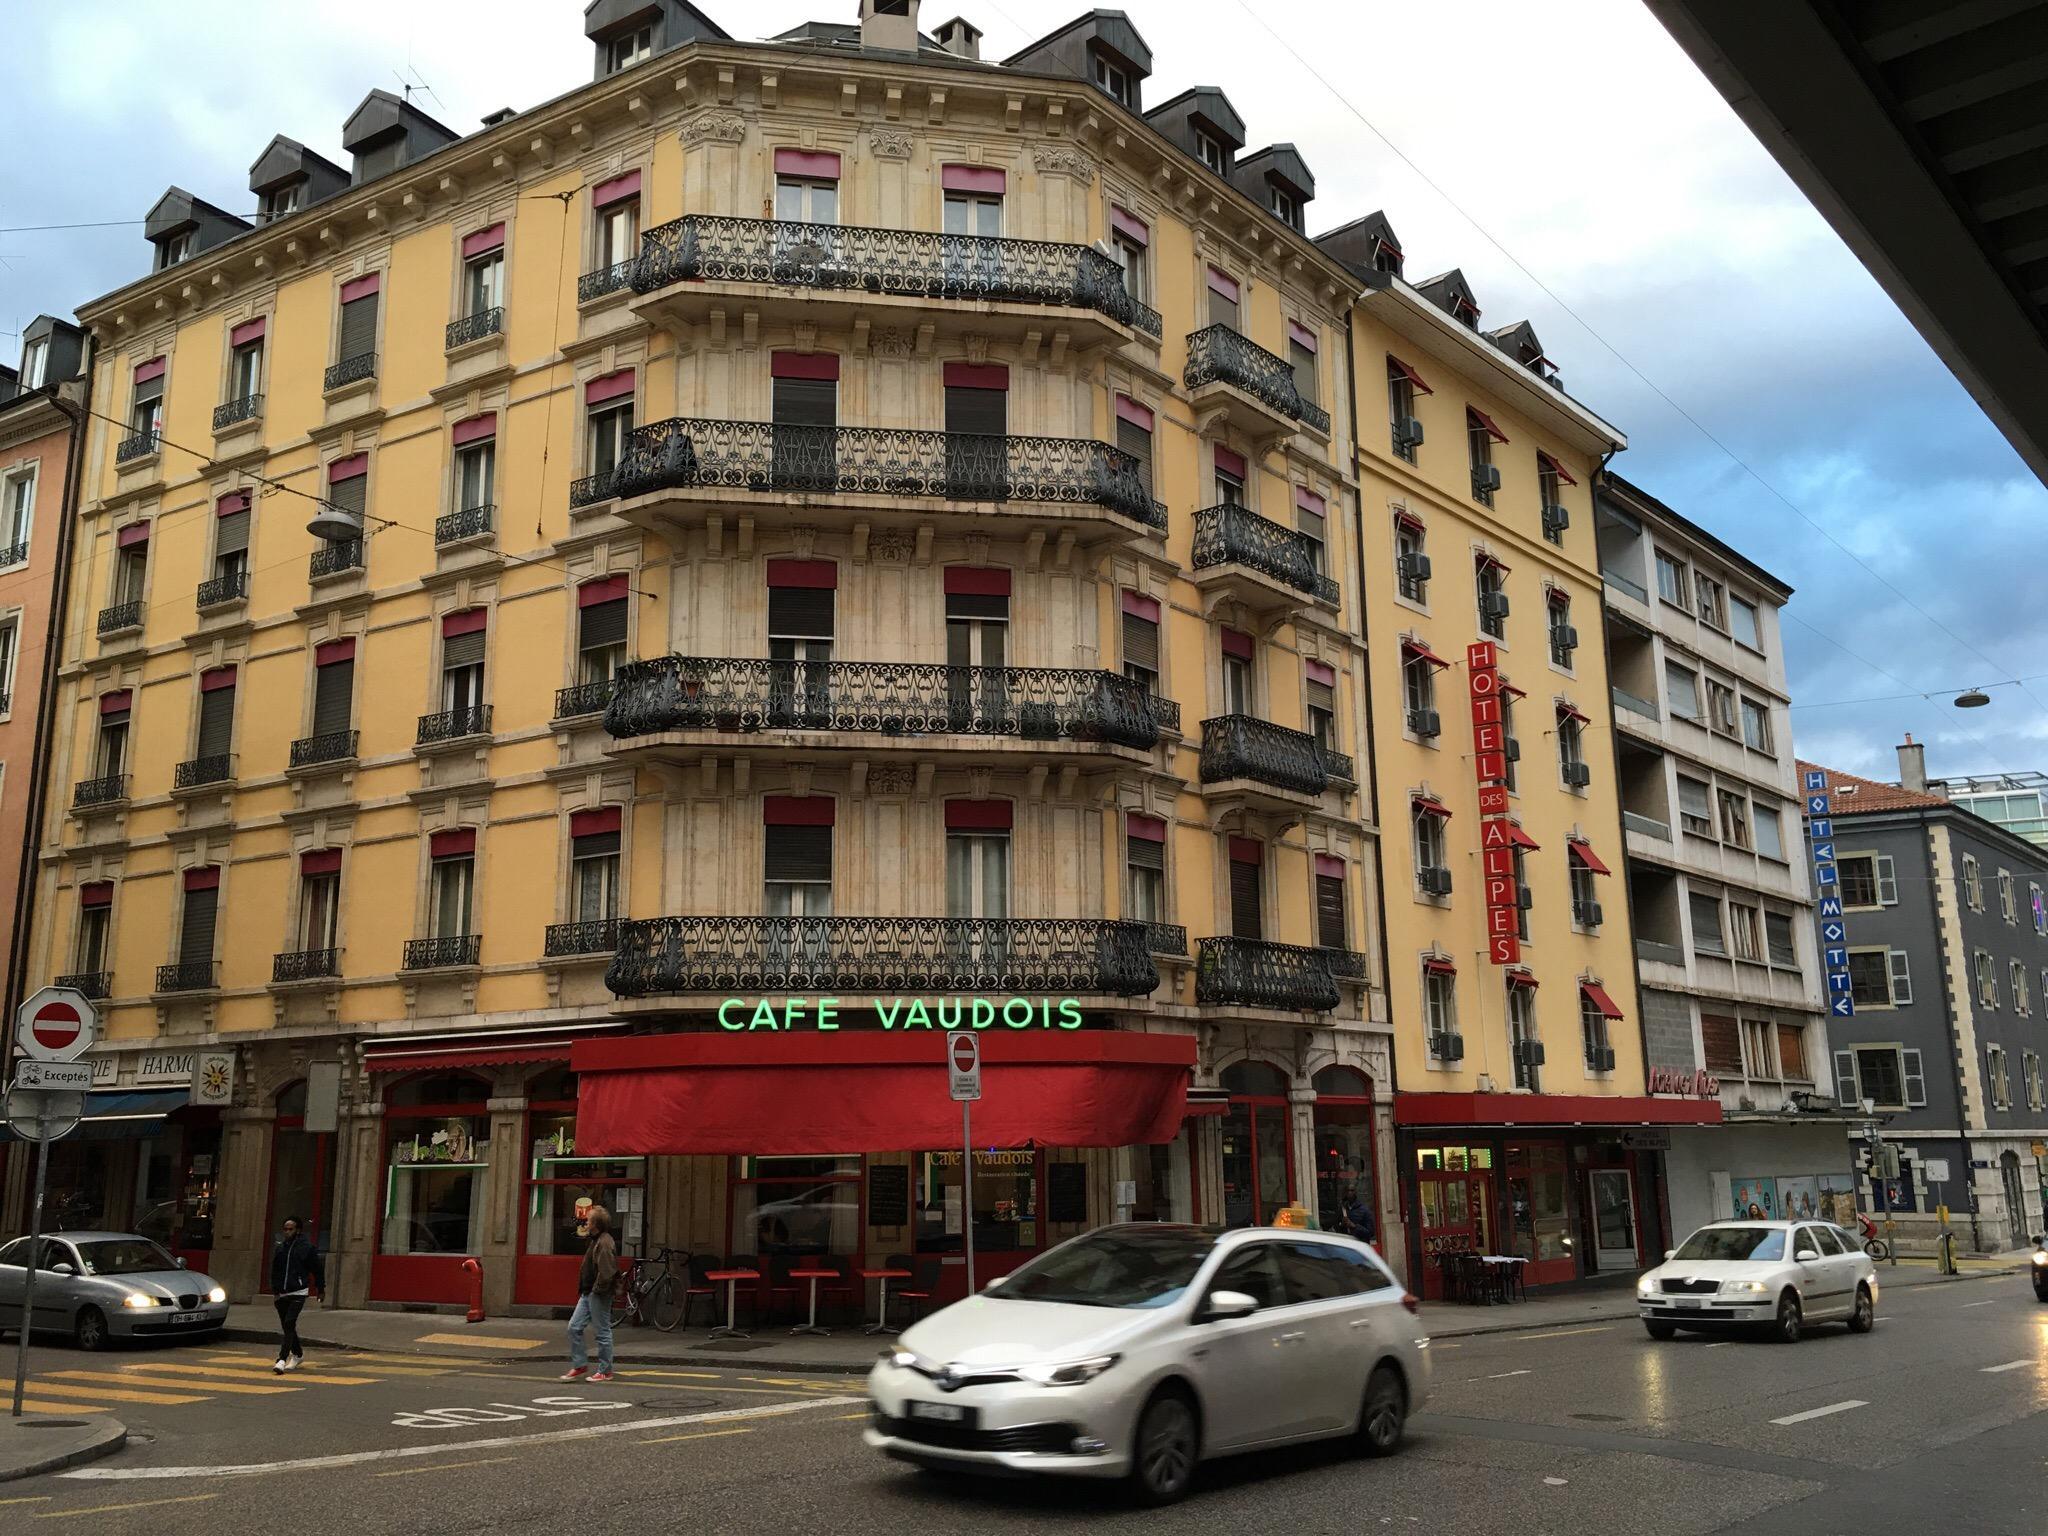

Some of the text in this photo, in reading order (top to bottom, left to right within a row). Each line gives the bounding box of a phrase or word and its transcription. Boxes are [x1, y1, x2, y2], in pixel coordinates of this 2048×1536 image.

[1471, 645, 1511, 961] HOTEL DES ALPES
[1808, 773, 1848, 1015] HOTEL MOTTE
[717, 997, 1083, 1031] CAFE VAUDOIS
[44, 1070, 89, 1083] Exceptés
[975, 1150, 1033, 1165] Vaudois
[391, 1396, 633, 1429] STOP
